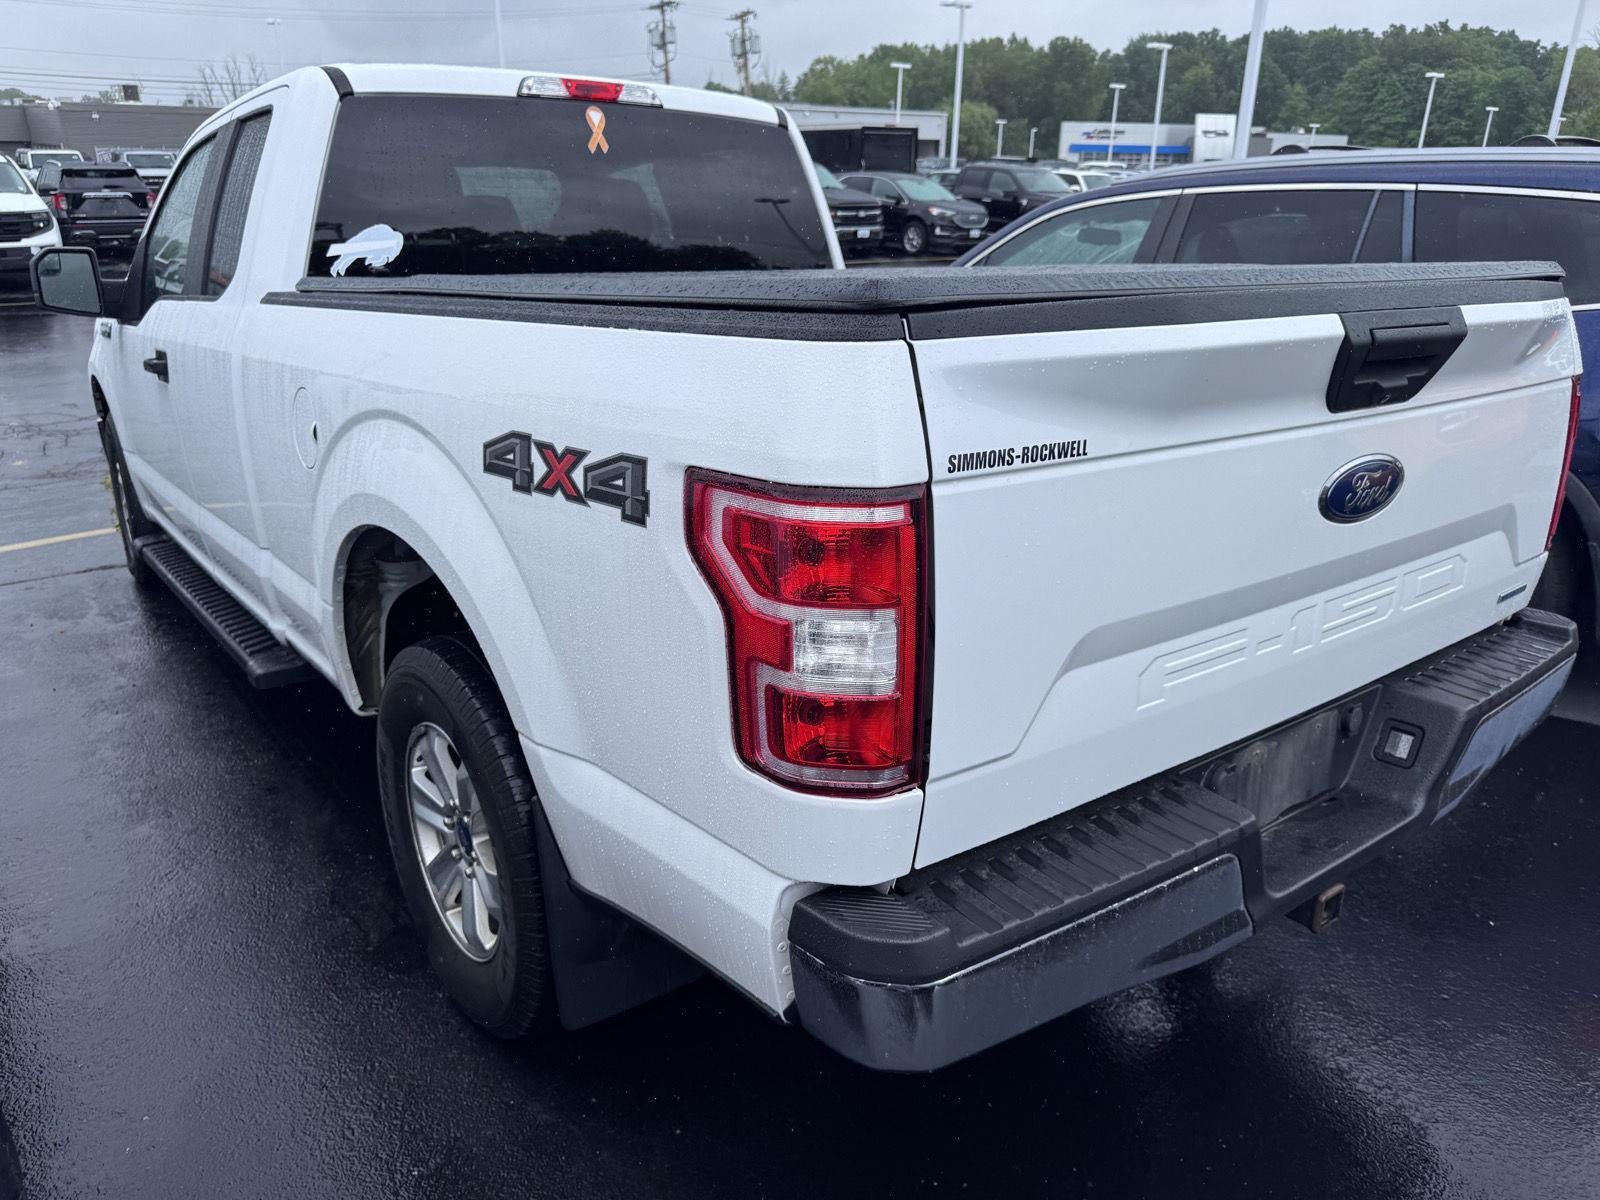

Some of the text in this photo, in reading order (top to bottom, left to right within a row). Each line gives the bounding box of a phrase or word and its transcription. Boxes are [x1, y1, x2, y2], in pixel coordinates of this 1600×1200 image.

[947, 439, 1088, 474] SIMMONS-ROCKWELL
[1343, 469, 1393, 513] Ford
[1136, 553, 1468, 712] F-150
